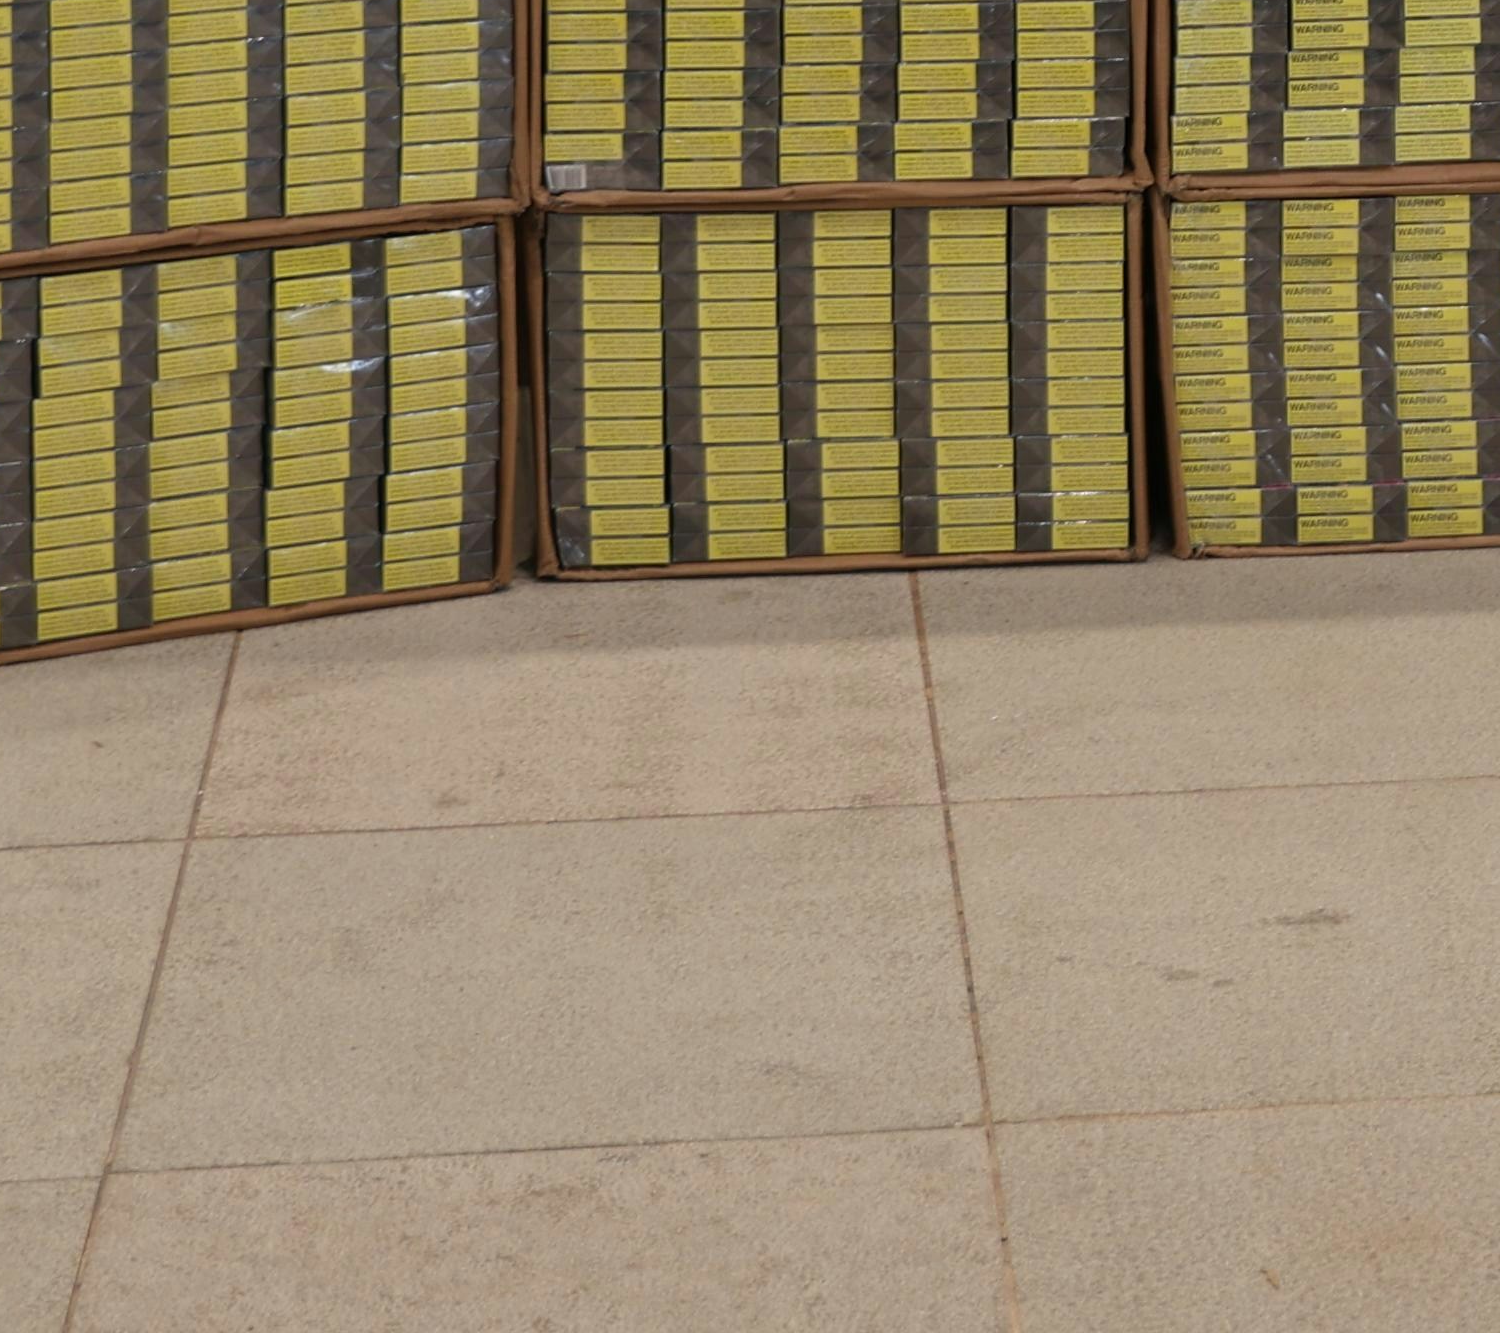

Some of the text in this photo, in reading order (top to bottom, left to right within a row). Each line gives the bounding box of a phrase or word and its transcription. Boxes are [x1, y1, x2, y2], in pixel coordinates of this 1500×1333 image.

[1296, 24, 1345, 33] WARNING
[1291, 82, 1340, 91] WARNING
[1175, 147, 1224, 156] WARNING
[1286, 314, 1334, 324] WARNING
[1396, 309, 1444, 319] WARNING
[1175, 319, 1223, 329] WARNING
[1176, 348, 1224, 358] WARNING
[1399, 366, 1447, 376] WARNING
[1289, 372, 1337, 382] WARNING
[1404, 424, 1452, 434] WARNING
[1183, 434, 1231, 444] WARNING
[1294, 458, 1342, 468] WARNING
[1301, 517, 1349, 527] WARNING
